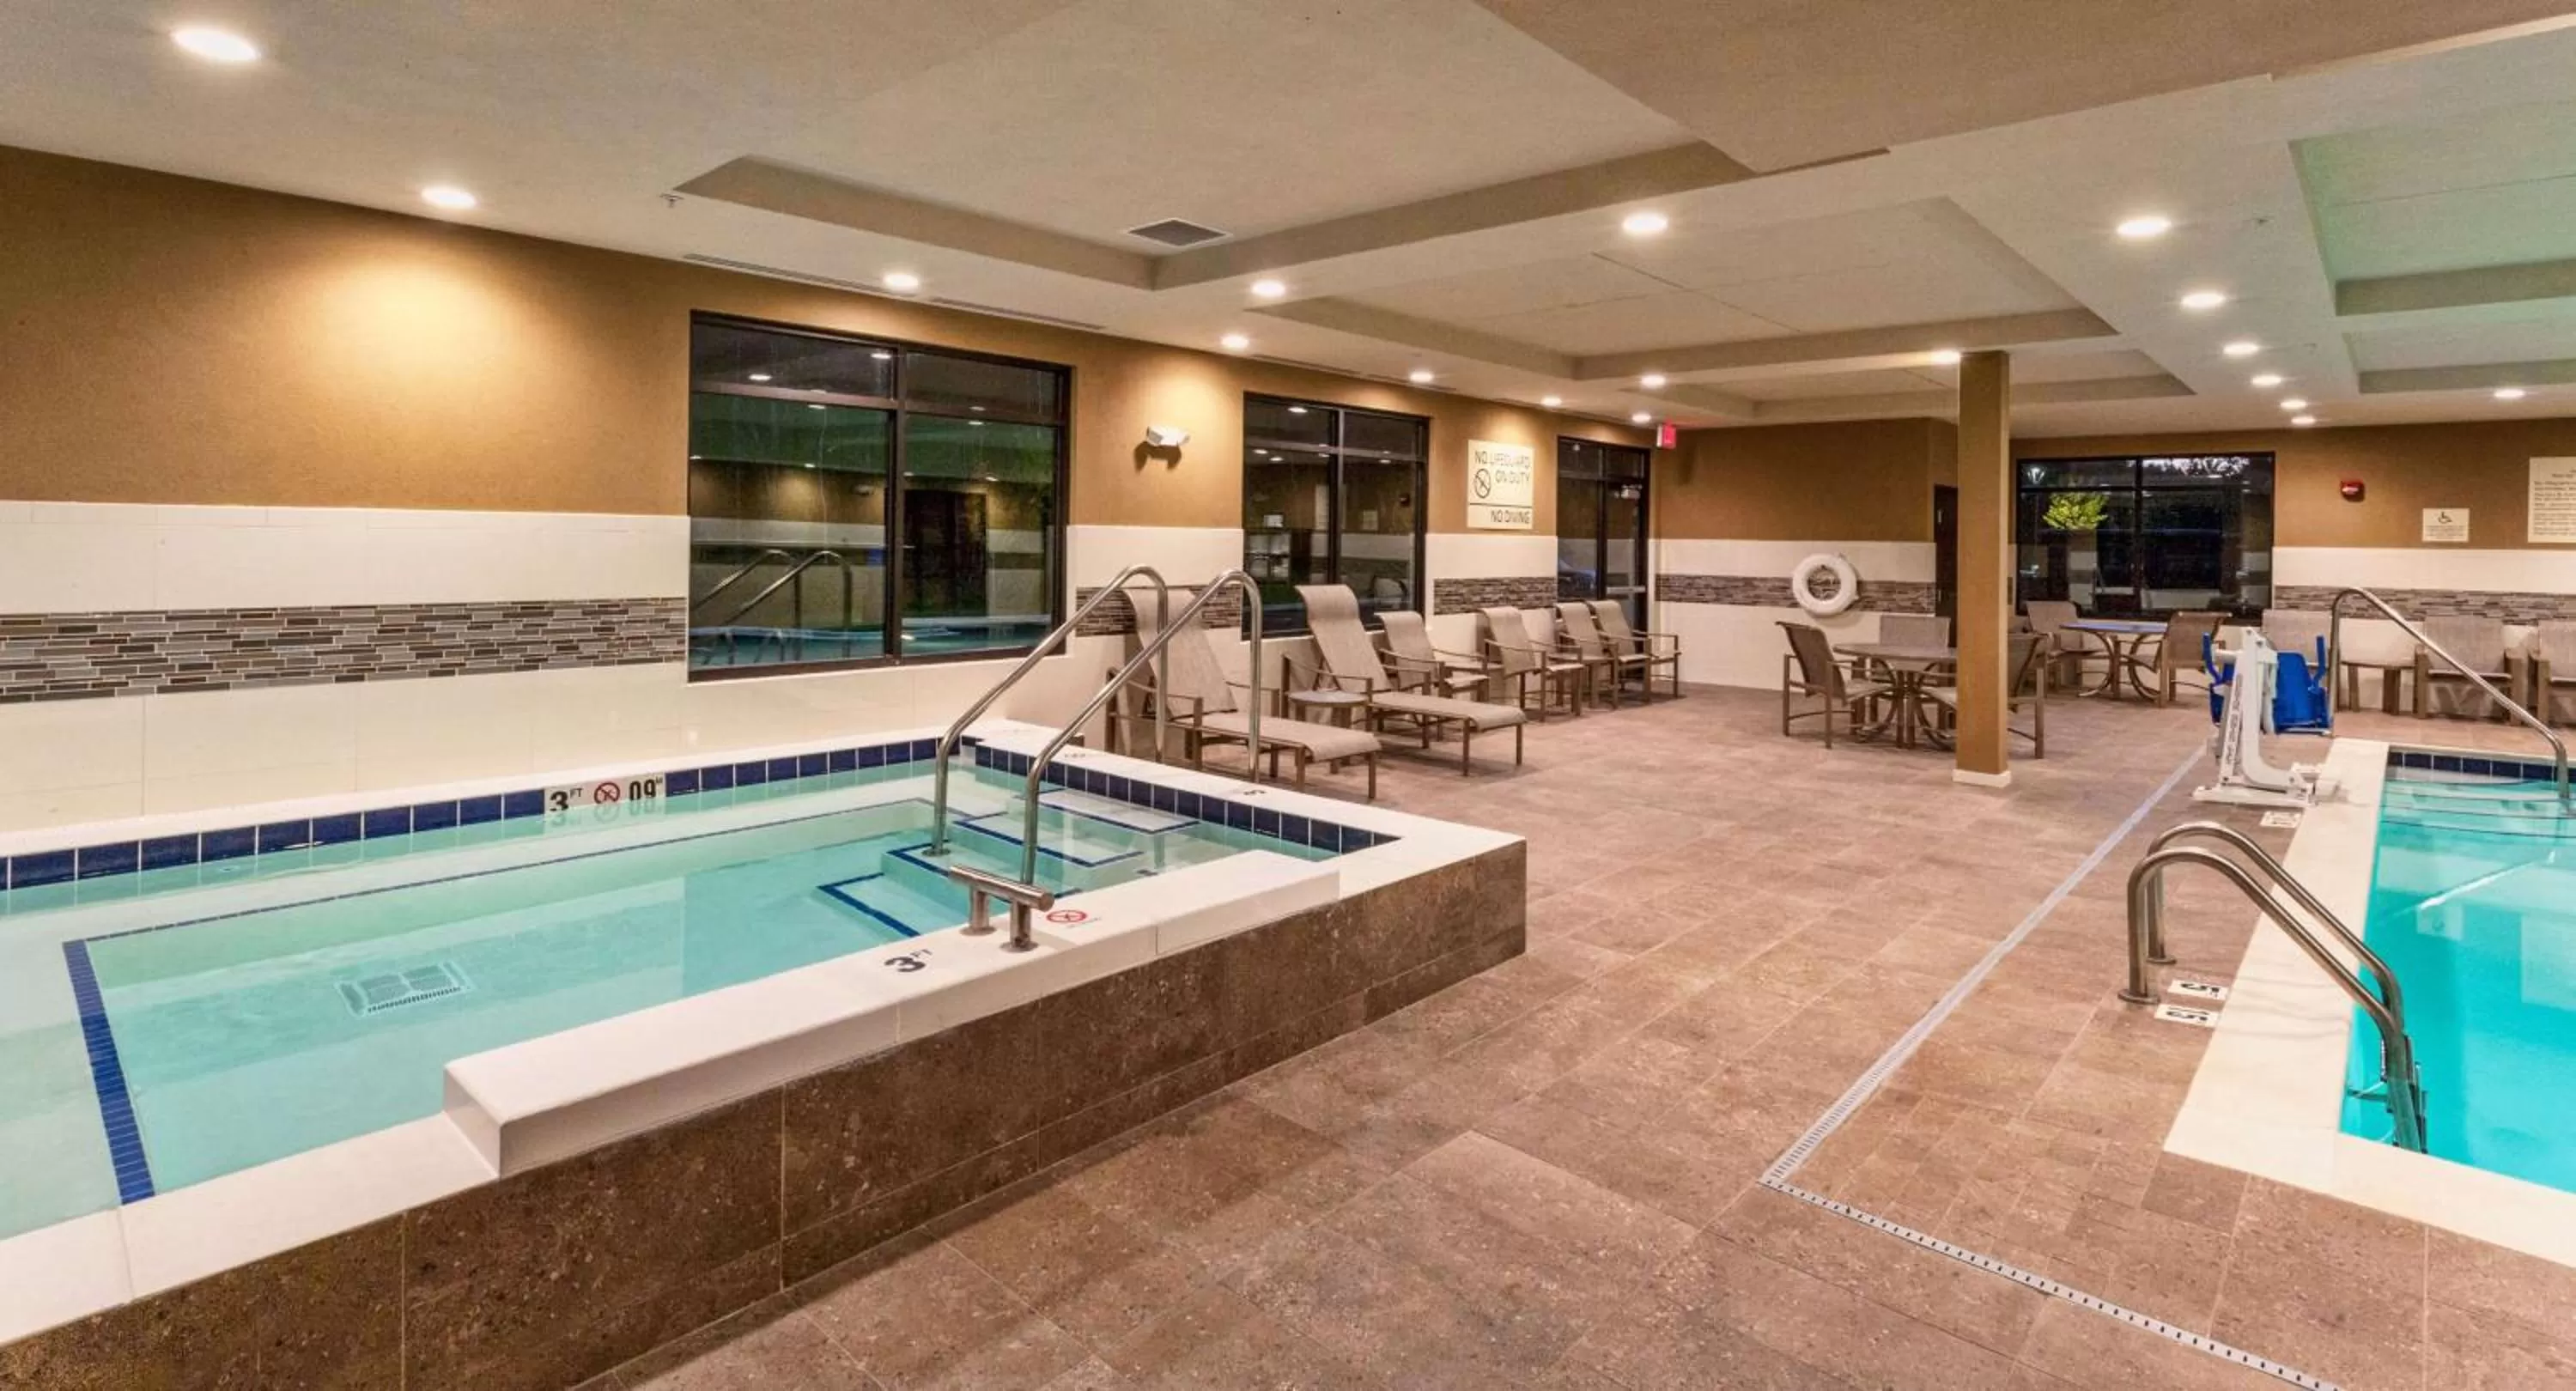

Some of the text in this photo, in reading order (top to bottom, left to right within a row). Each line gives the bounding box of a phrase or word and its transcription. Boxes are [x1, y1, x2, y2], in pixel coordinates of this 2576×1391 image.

[1474, 451, 1488, 465] NO
[1491, 509, 1503, 523] NO
[550, 791, 568, 811] 3
[884, 956, 927, 973] 3
